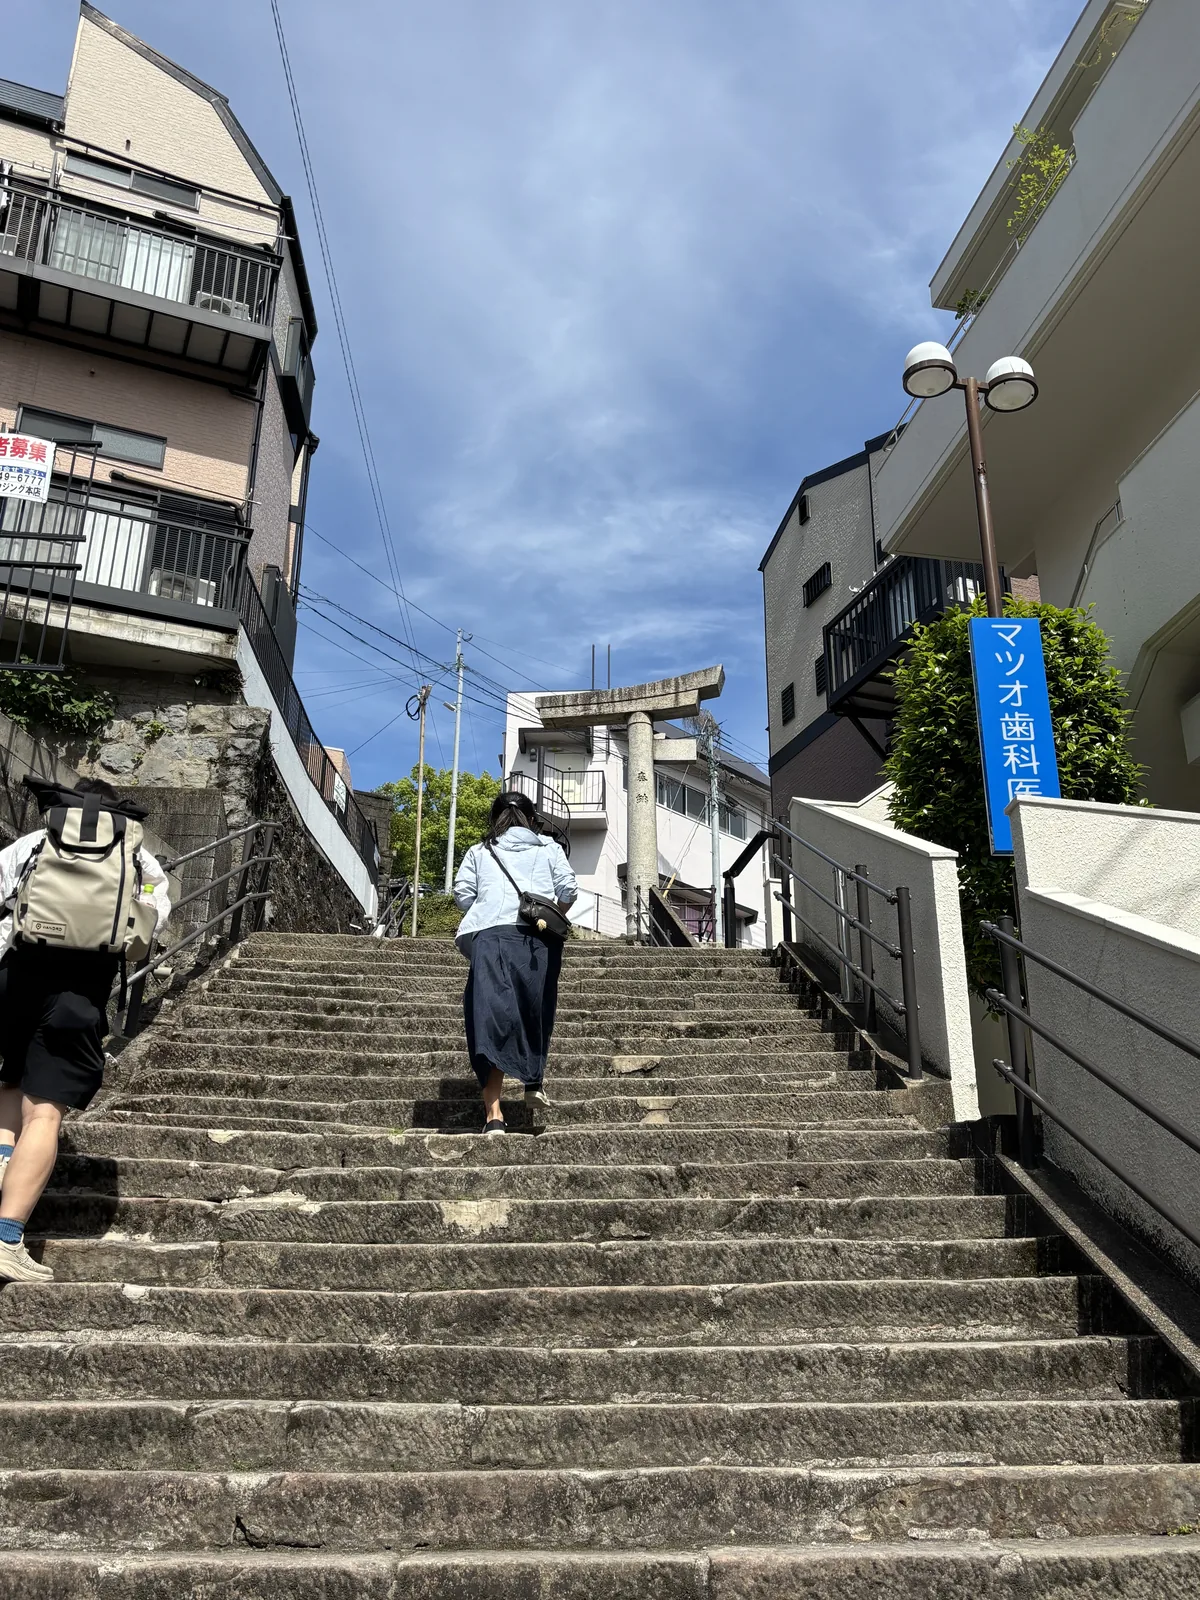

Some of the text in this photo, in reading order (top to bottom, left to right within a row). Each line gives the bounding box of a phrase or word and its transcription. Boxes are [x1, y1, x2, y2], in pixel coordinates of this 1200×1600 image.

[0, 482, 42, 496] ジング本店
[991, 624, 1043, 799] マツオ歯科医
